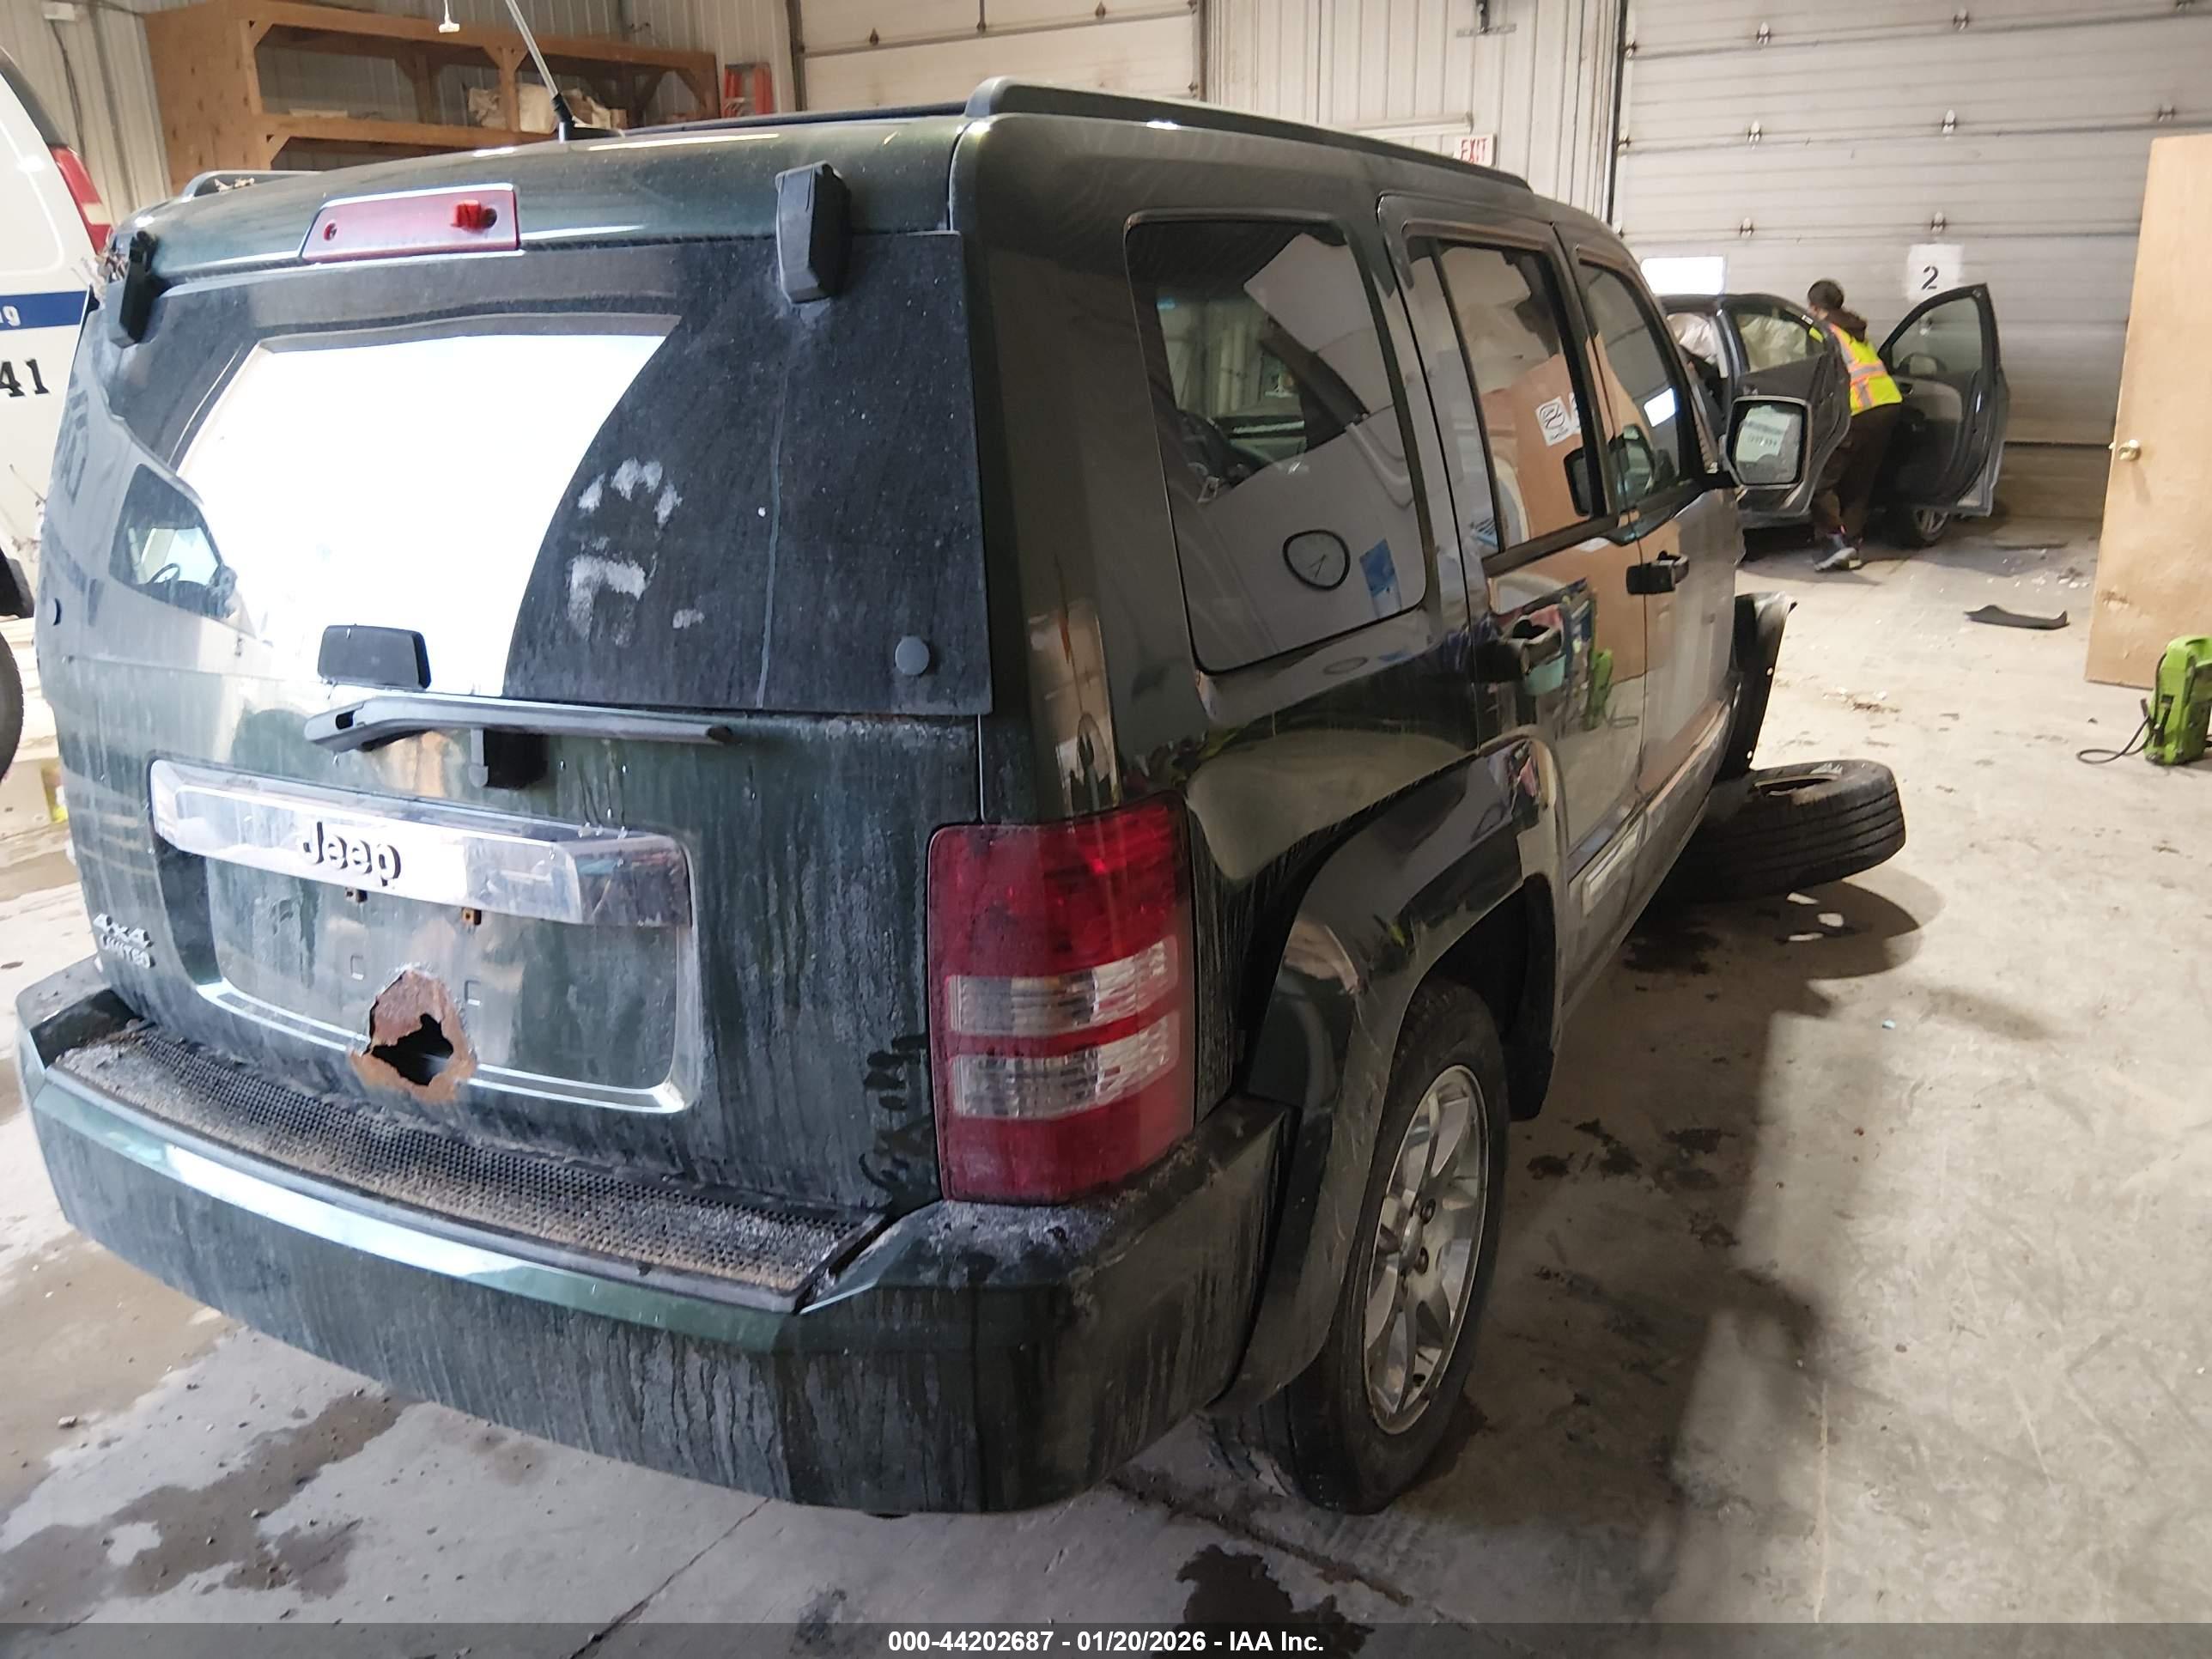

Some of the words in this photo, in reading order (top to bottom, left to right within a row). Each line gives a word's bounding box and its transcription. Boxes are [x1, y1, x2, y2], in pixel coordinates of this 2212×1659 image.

[1461, 137, 1487, 163] EXIT
[1921, 264, 1939, 290] 2
[298, 820, 402, 889] Jeep
